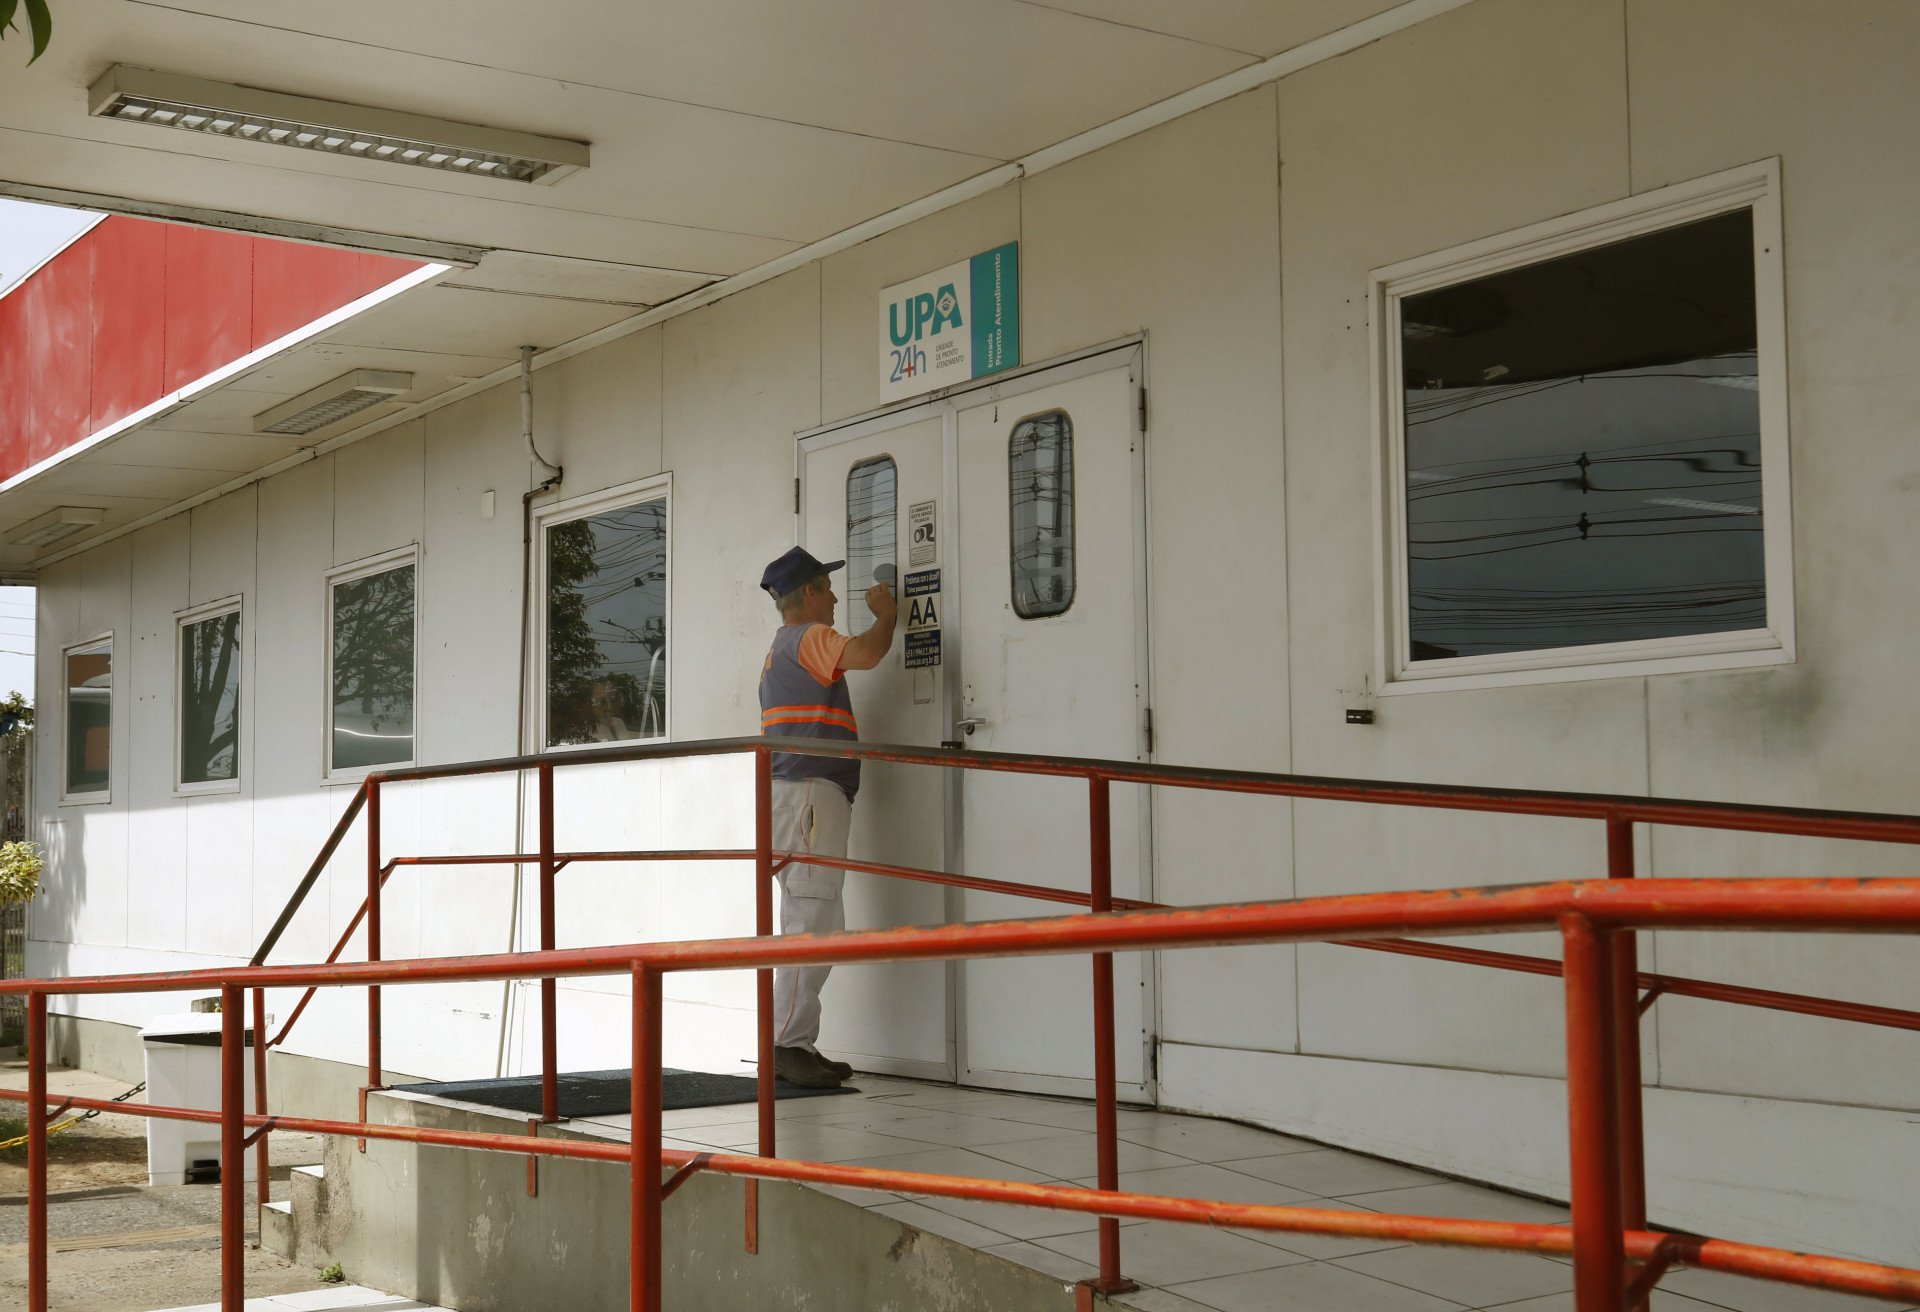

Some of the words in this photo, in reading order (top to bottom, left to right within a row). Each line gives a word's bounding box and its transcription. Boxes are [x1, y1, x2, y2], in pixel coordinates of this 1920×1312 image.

[994, 253, 1002, 326] Atendimento
[889, 283, 963, 347] UPA
[935, 340, 954, 353] UNIDADE
[935, 353, 942, 361] DE
[941, 347, 959, 359] PRONTO
[889, 344, 926, 383] 24h
[935, 355, 965, 369] ATENDIMENTO
[908, 597, 937, 626] AA
